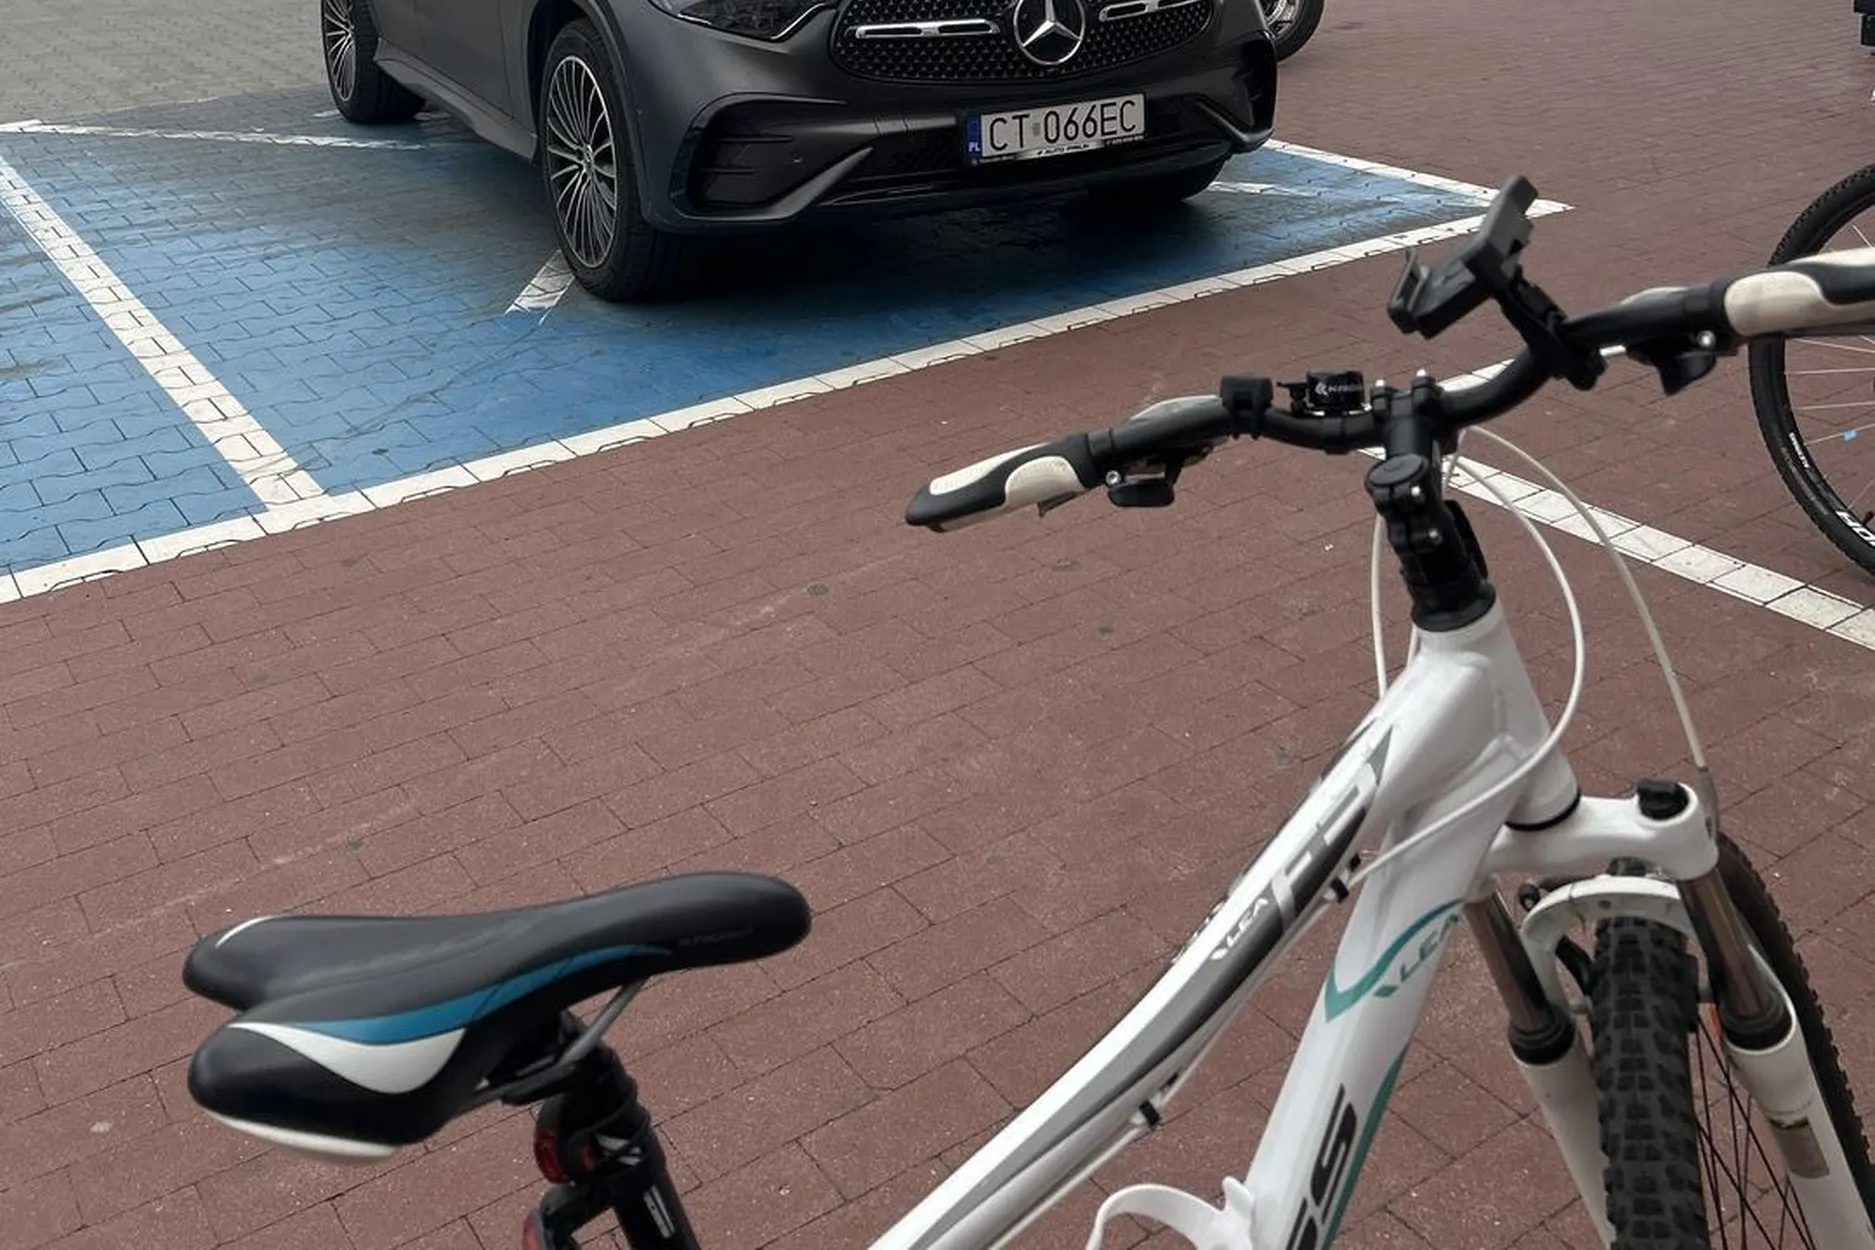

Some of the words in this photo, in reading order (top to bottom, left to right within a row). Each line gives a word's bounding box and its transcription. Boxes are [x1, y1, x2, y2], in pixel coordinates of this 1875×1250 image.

[968, 142, 981, 152] PL
[989, 113, 1030, 151] CT
[1043, 100, 1136, 144] 066EC
[1226, 897, 1270, 949] LEA
[1399, 913, 1460, 982] LEA
